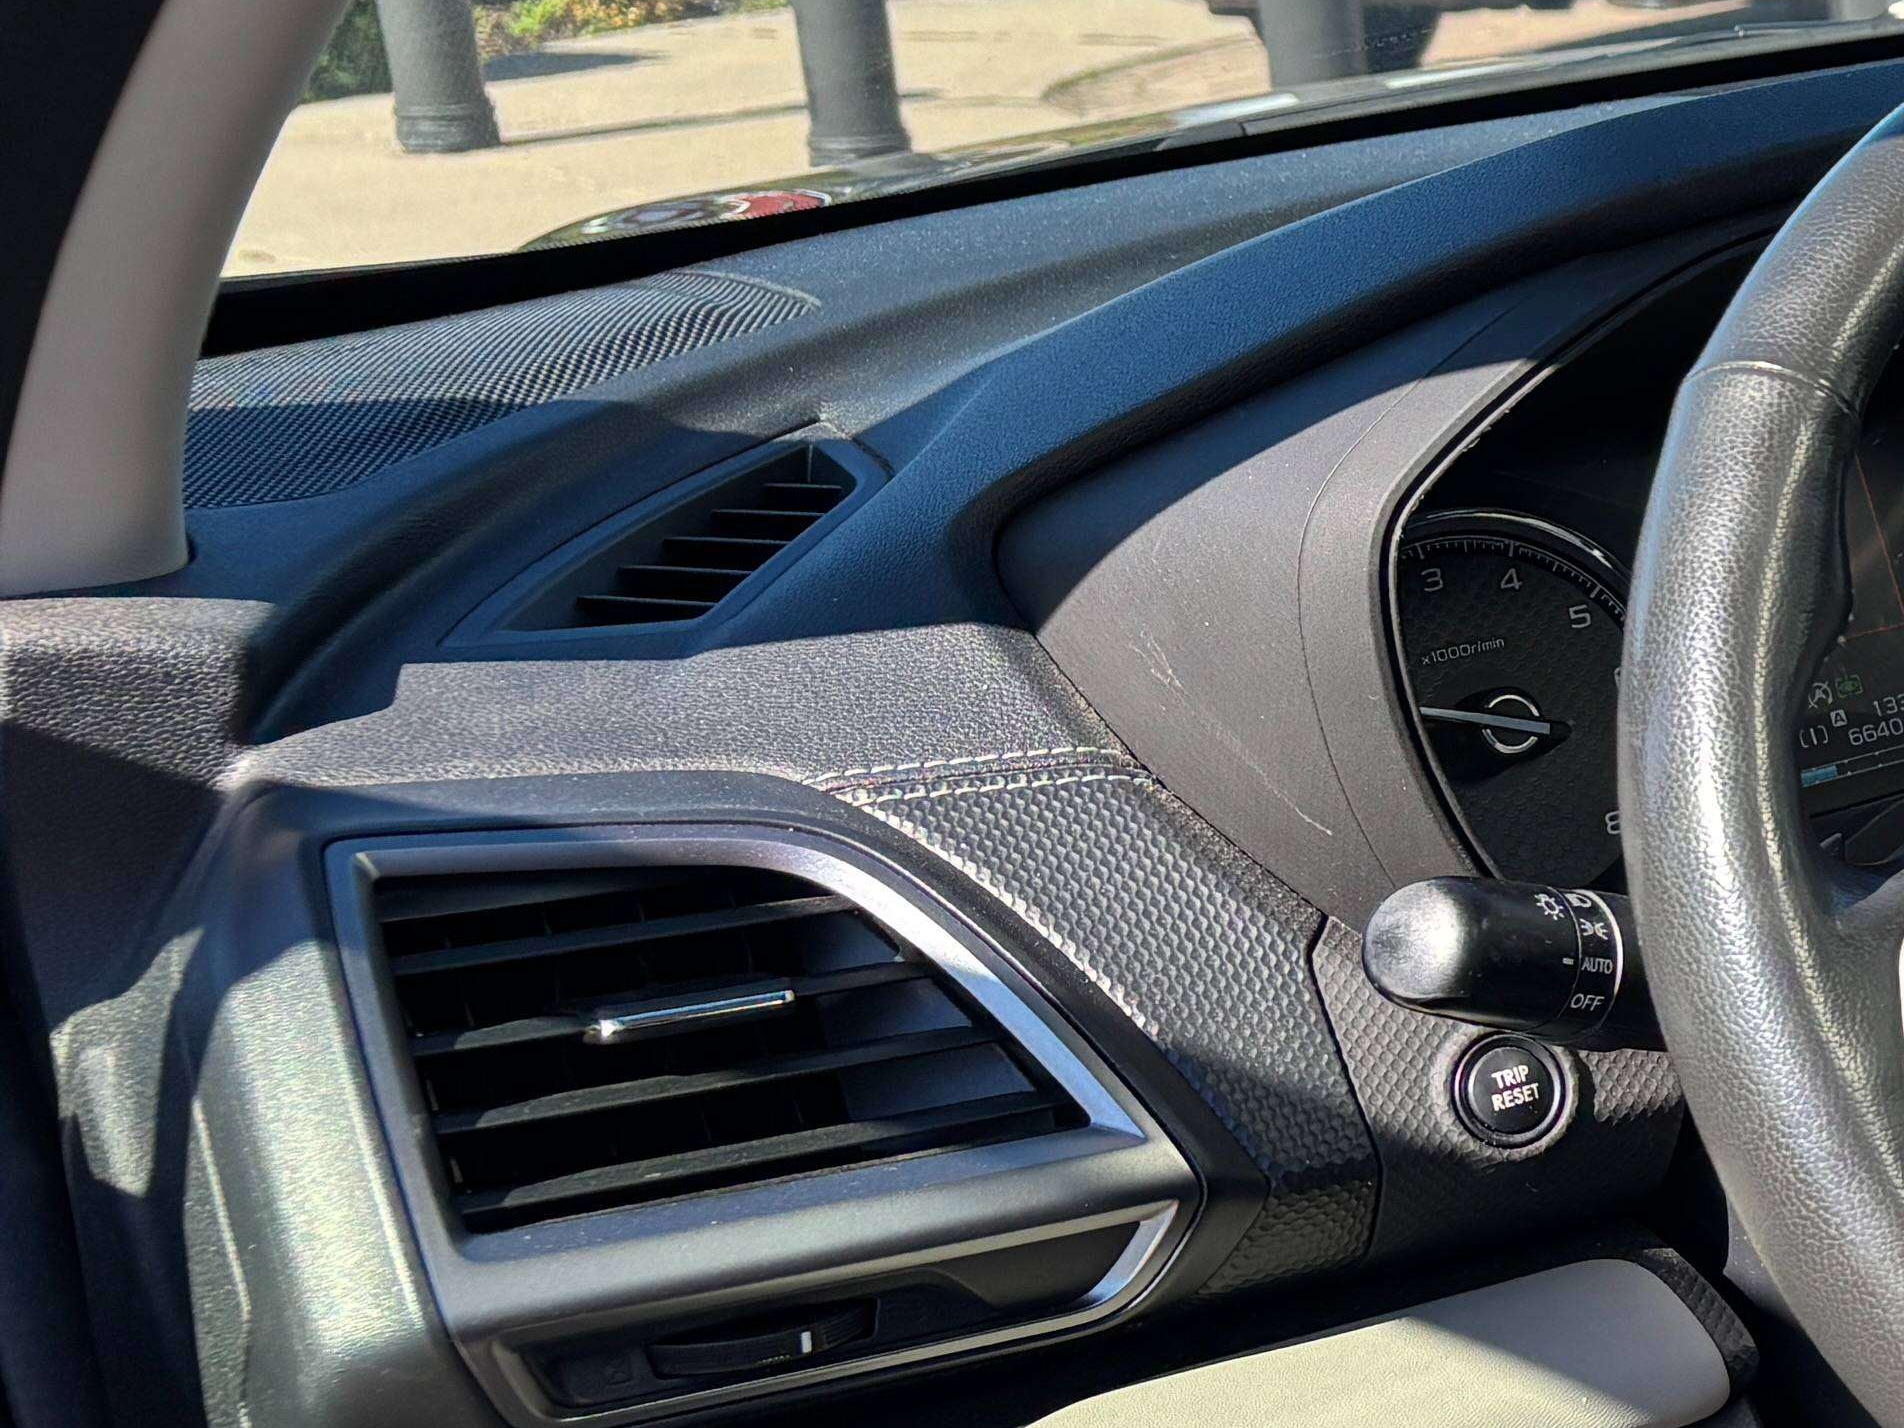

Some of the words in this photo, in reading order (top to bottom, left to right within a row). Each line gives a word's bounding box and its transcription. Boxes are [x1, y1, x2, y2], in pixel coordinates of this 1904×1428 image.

[1420, 568, 1444, 592] 3
[1500, 568, 1523, 591] 4
[1569, 604, 1592, 629] 5
[1581, 957, 1613, 974] AUTO
[1570, 993, 1605, 1011] OFF
[1490, 1064, 1529, 1089] TRIP
[1491, 1082, 1539, 1112] RESET
